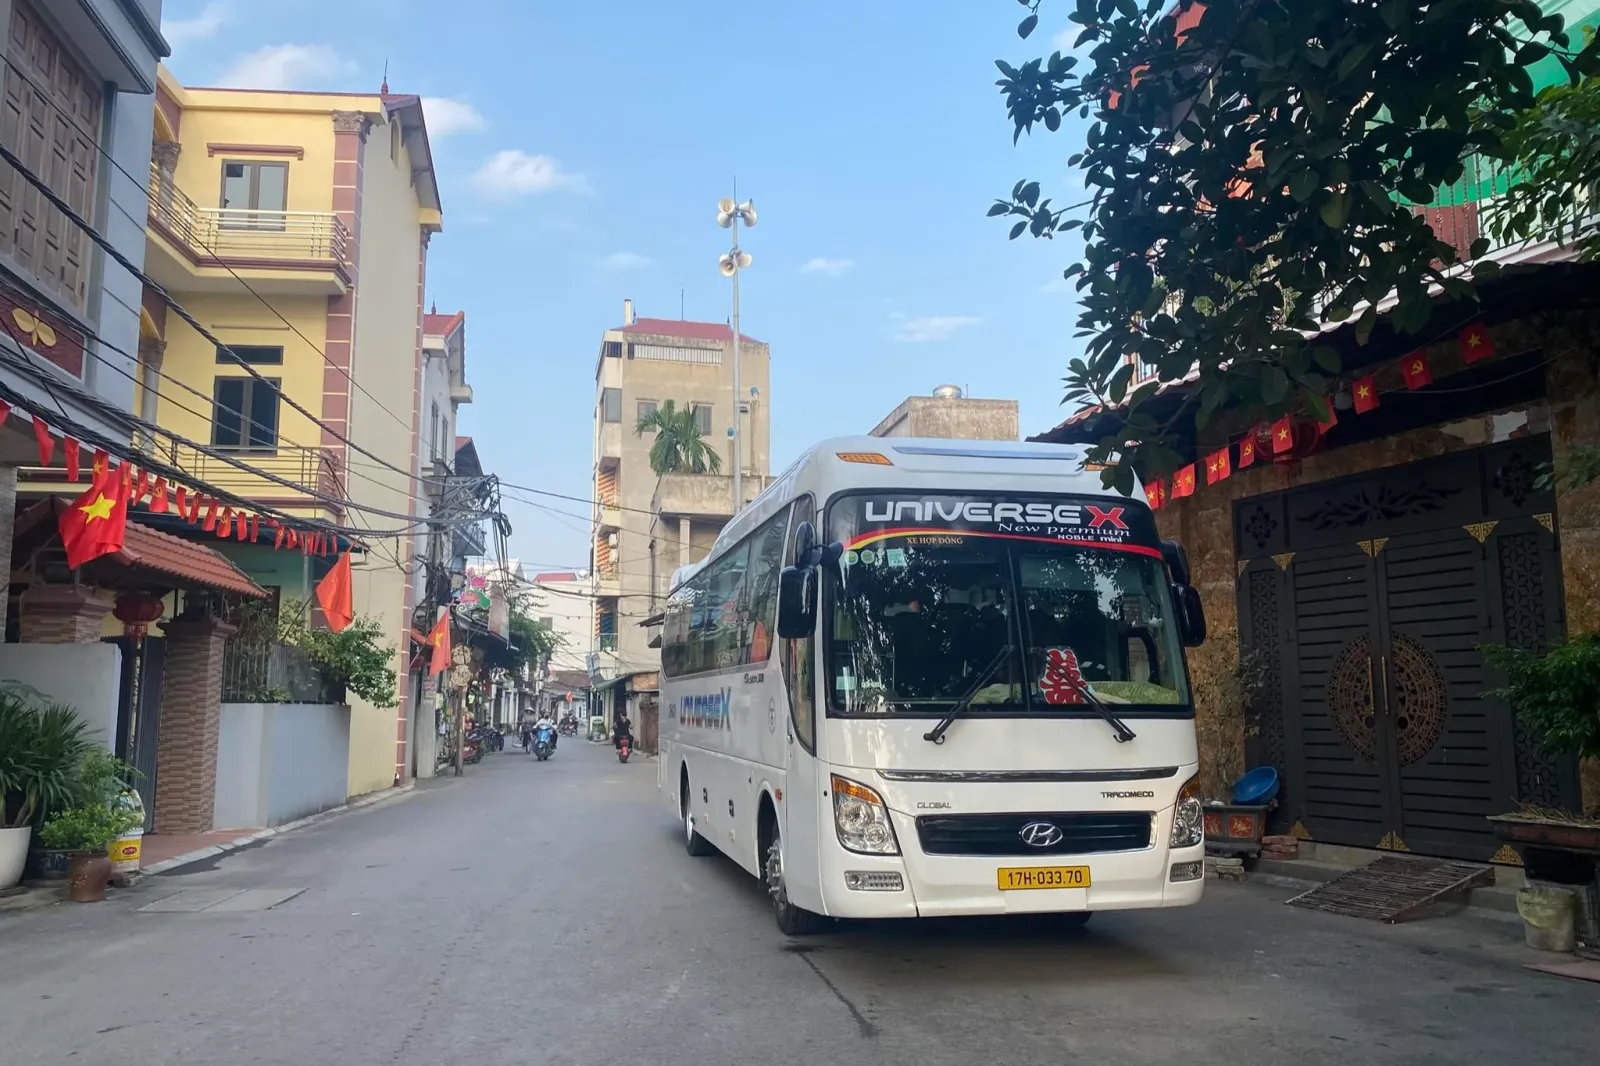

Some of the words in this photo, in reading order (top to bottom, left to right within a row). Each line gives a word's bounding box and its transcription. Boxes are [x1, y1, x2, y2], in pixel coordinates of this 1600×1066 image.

[997, 523, 1040, 533] New
[1047, 526, 1131, 538] premium
[1100, 790, 1154, 799] TRACOMECO
[916, 801, 952, 809] GLOBAL
[1007, 869, 1083, 886] 17H-033.70
